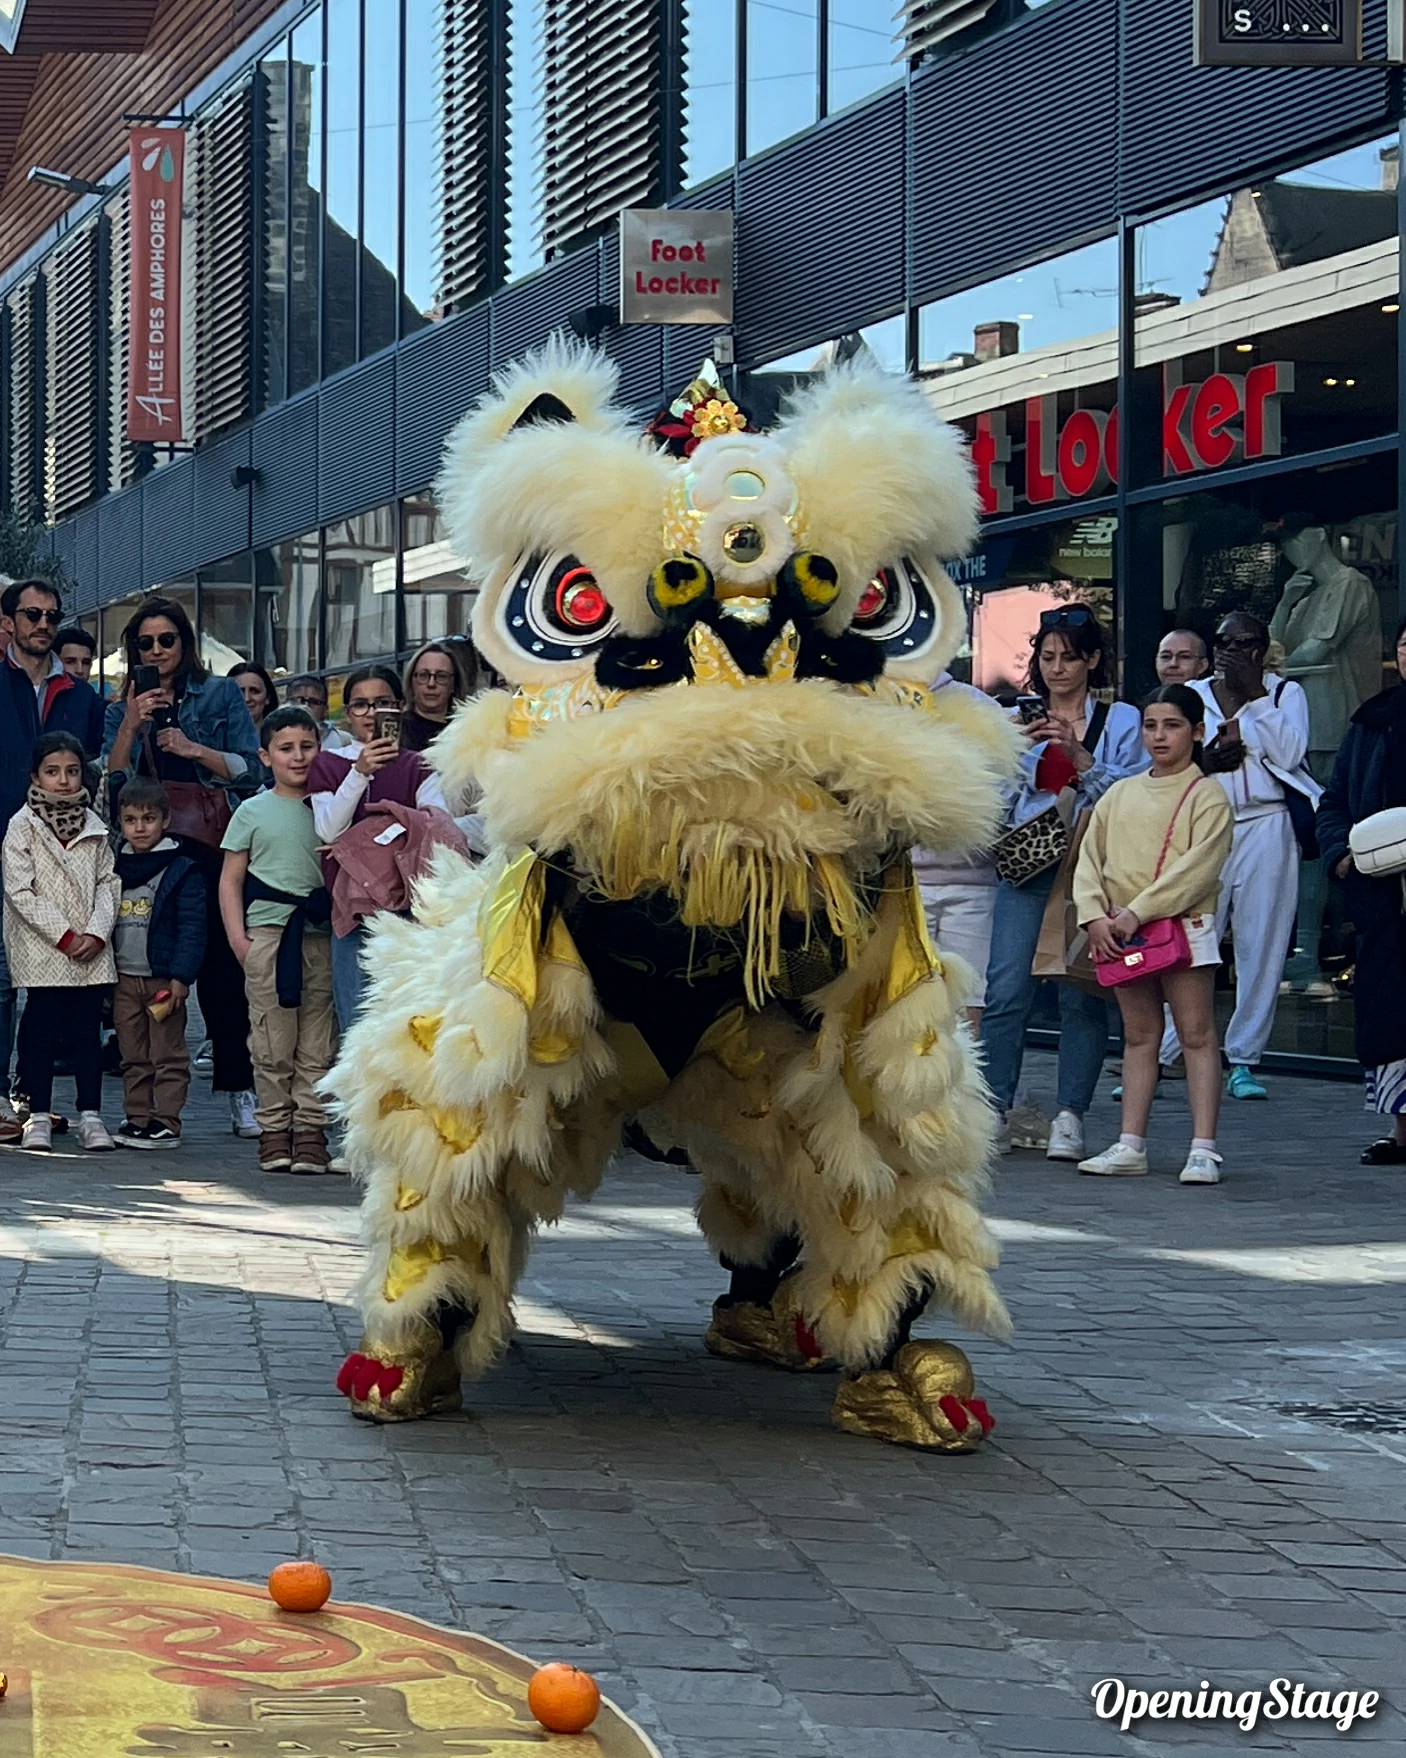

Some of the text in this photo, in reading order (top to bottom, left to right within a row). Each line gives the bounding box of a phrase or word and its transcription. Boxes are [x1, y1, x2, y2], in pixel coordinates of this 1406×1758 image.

[149, 198, 166, 301] AMPHORES
[651, 238, 706, 264] Foot
[635, 270, 721, 295] Locker
[149, 306, 165, 345] DES
[1058, 547, 1082, 558] new
[964, 554, 987, 580] THE
